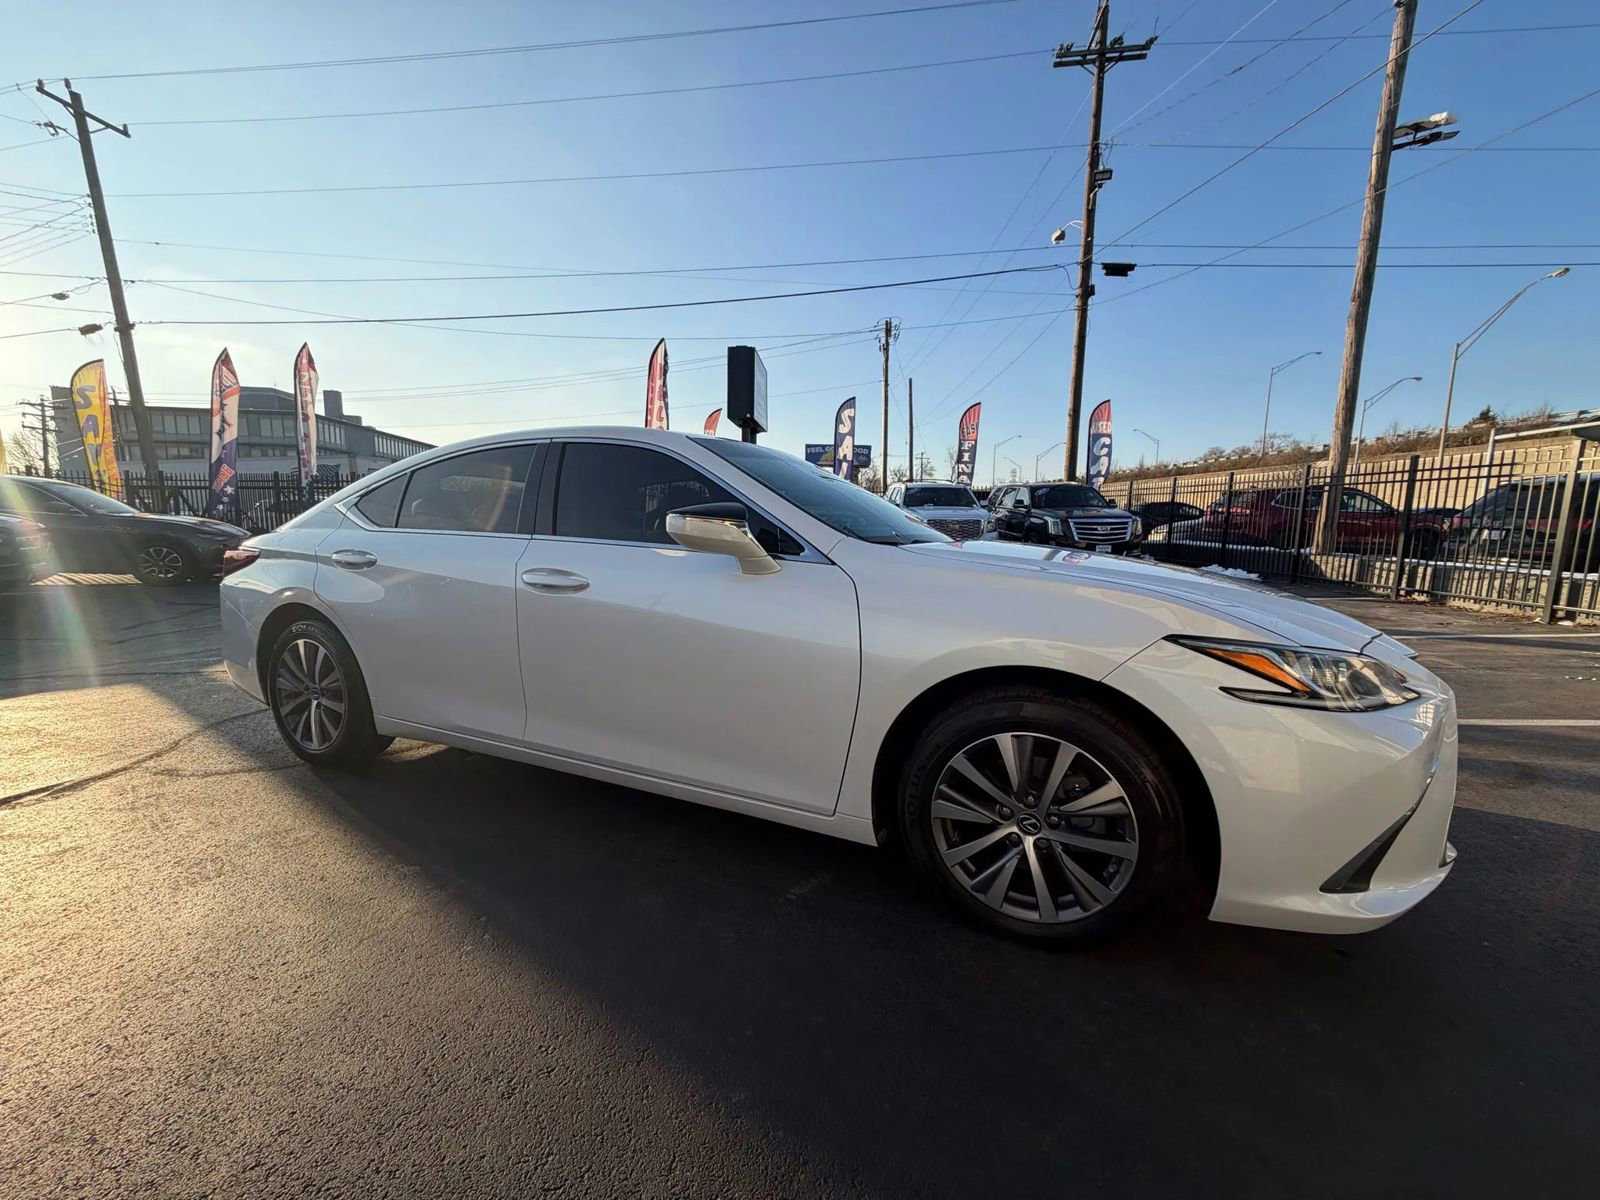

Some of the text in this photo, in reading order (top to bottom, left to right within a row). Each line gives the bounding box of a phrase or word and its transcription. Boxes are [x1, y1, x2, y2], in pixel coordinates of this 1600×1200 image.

[961, 422, 977, 438] EAS
[1090, 421, 1112, 433] USED
[807, 446, 824, 454] FEEL
